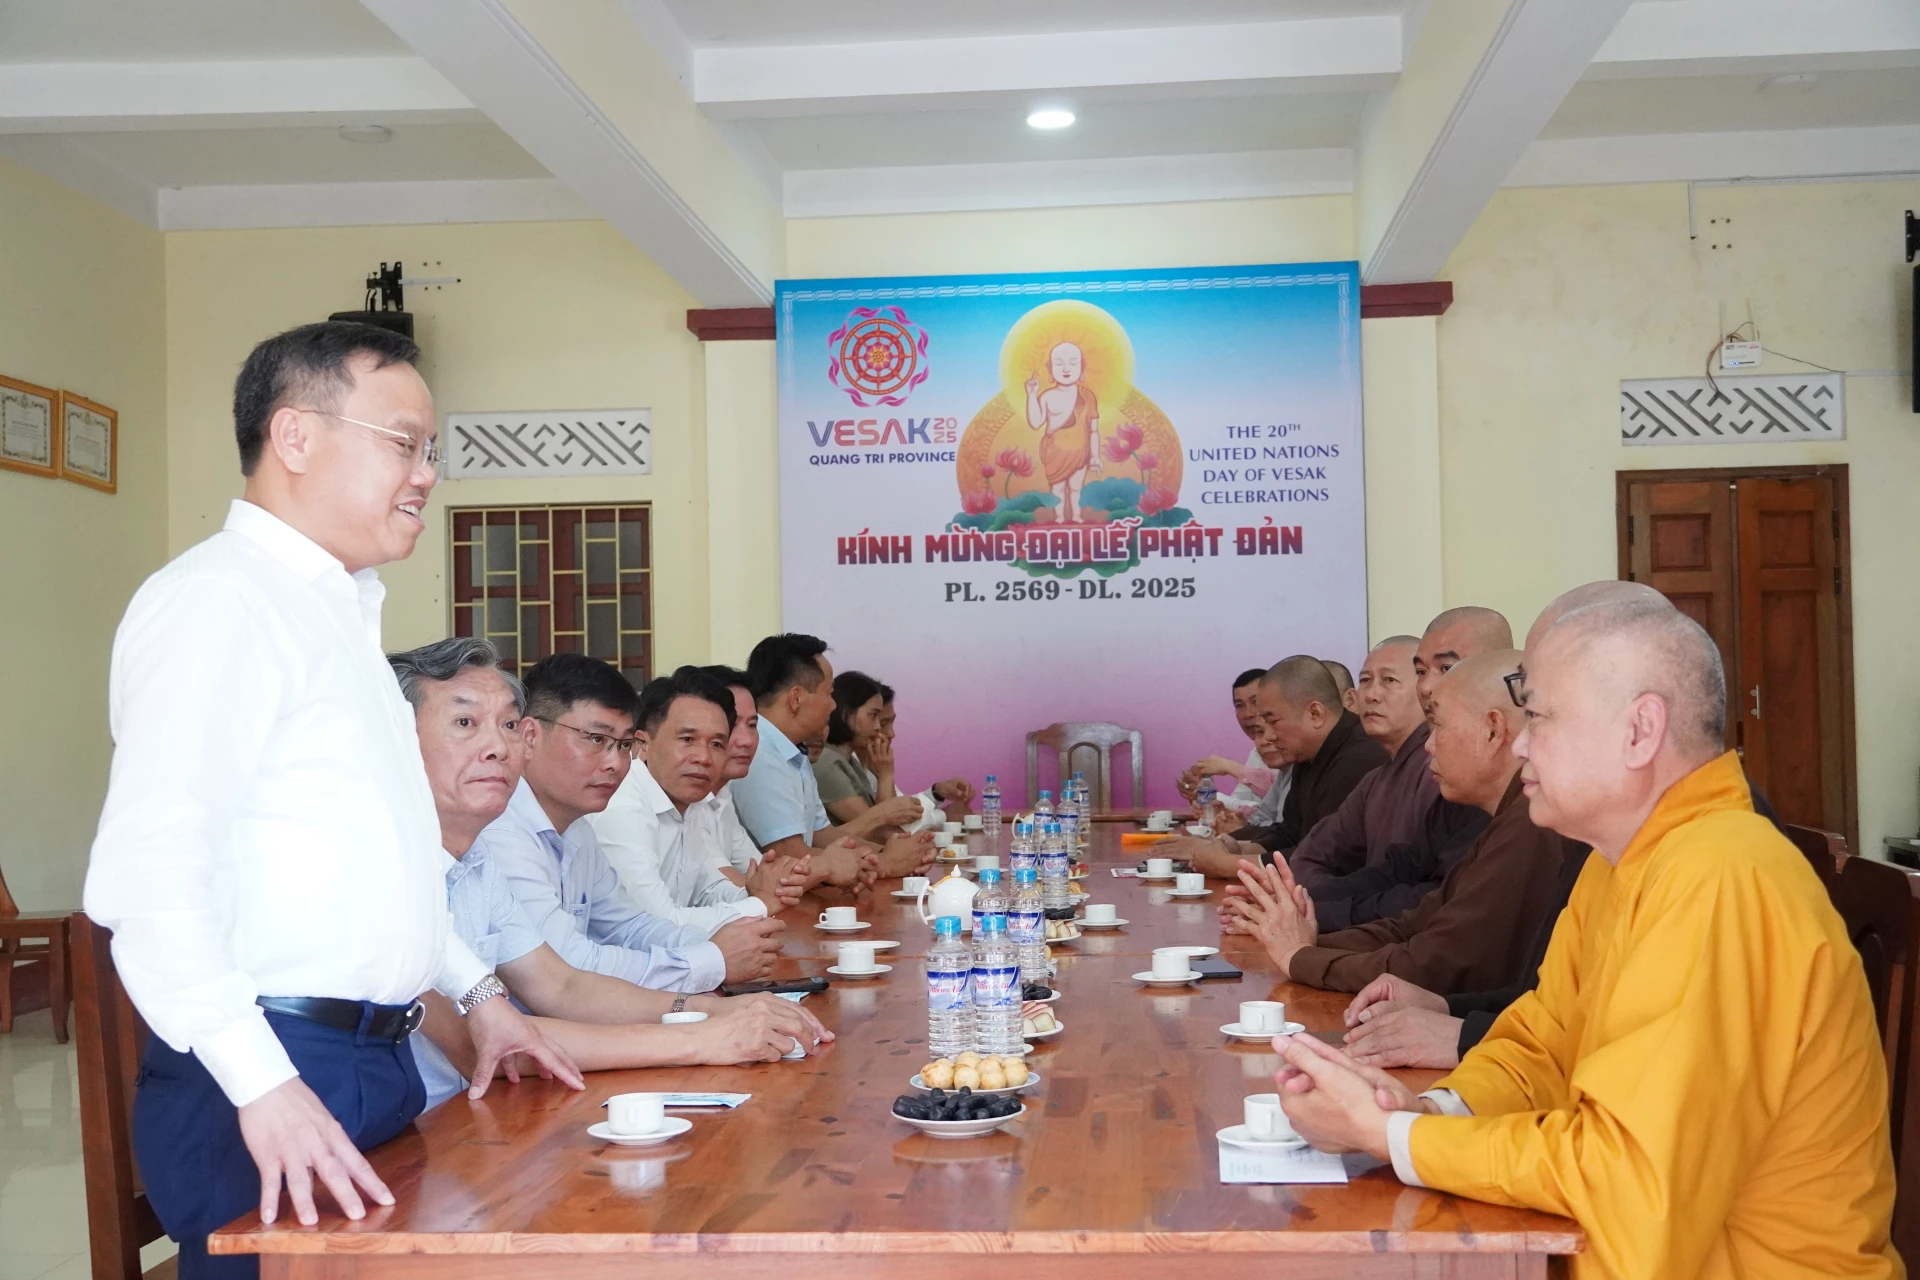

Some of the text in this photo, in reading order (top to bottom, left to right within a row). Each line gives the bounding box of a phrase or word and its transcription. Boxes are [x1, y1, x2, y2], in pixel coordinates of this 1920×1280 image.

[807, 418, 931, 447] VESAK
[1226, 425, 1261, 438] THE
[809, 451, 956, 466] QUANG TRI PROVINCE
[1189, 444, 1340, 461] UNITED NATIONS
[1203, 466, 1327, 483] DAY OF VESAK
[1201, 488, 1329, 504] CELEBRATIONS
[837, 516, 1303, 568] KÍNH MỪNG ĐẠI LỄ PHẬT ĐẢN
[945, 583, 986, 602] PL.
[995, 580, 1060, 600] 2569
[1078, 579, 1122, 599] DL.
[1131, 577, 1196, 598] 2025
